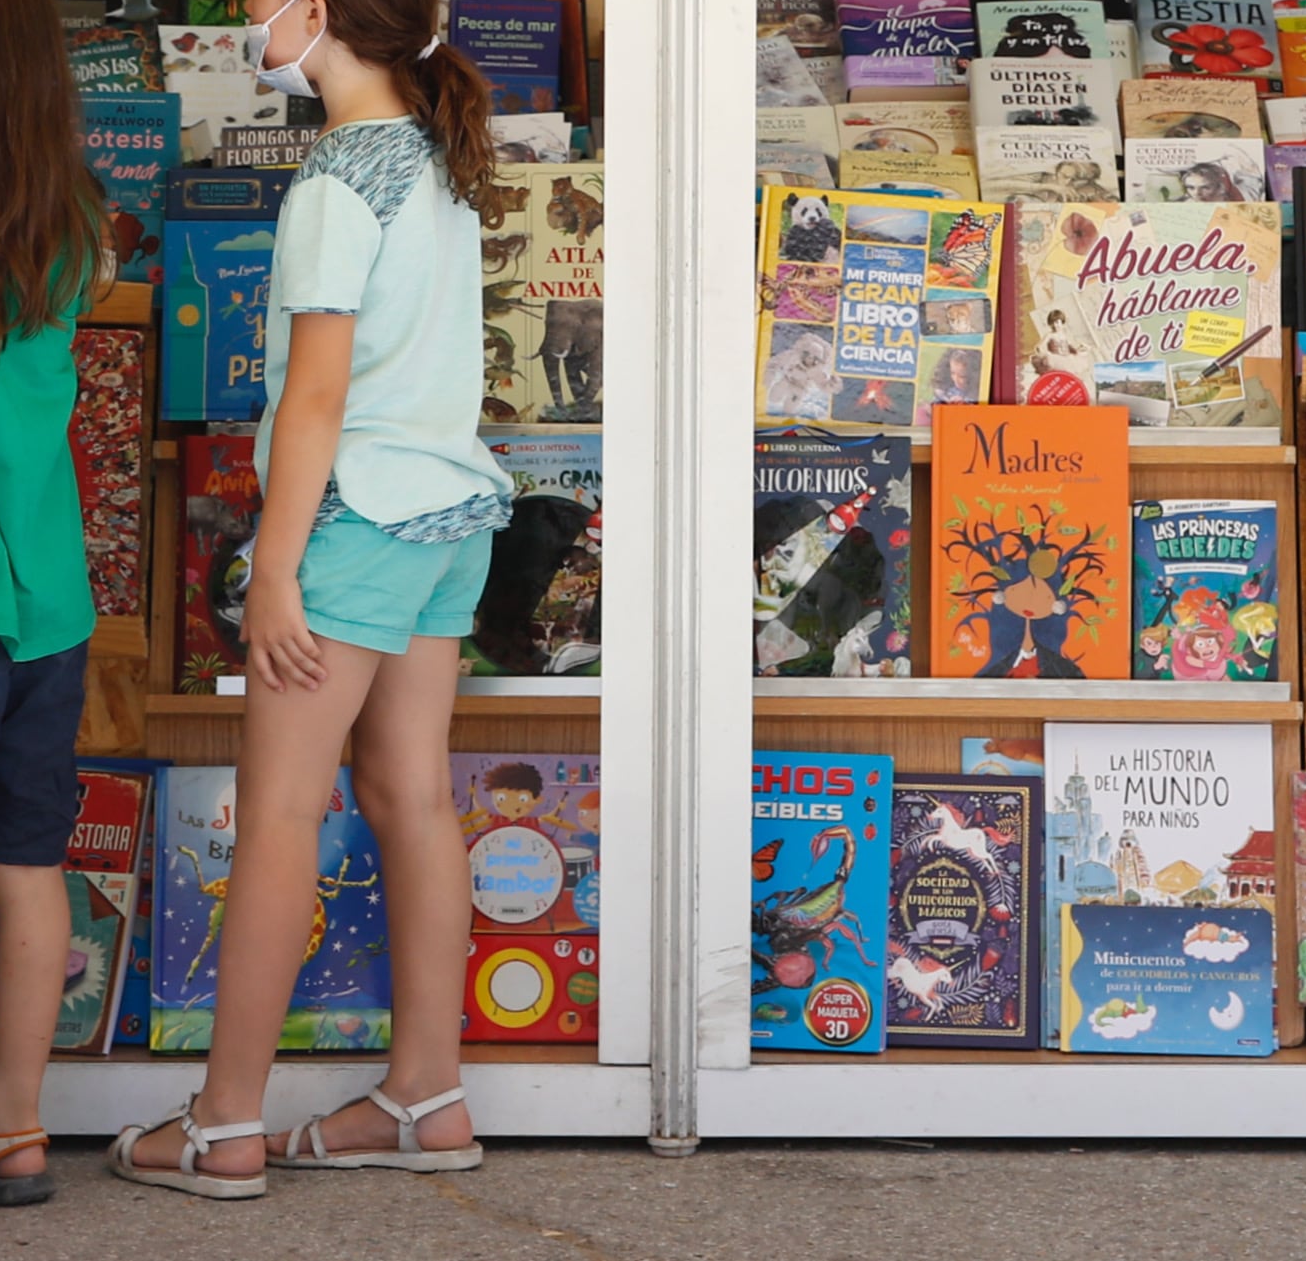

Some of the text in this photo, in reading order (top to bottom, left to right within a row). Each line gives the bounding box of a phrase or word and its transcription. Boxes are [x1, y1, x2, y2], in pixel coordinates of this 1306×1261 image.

[458, 16, 556, 34] Peces de mar
[991, 69, 1072, 82] ÚLTIMOS
[1012, 82, 1087, 93] DÍAS EN
[1002, 93, 1072, 105] BERLÍN
[236, 129, 294, 147] HONGOS
[226, 149, 279, 166] FLORES
[1078, 229, 1258, 289] Abuela,
[846, 270, 923, 286] MI PRIMER
[845, 281, 920, 304] GRAN
[1097, 282, 1240, 326] háblame
[842, 303, 919, 325] LIBRO
[842, 325, 916, 347] DE LA
[1115, 332, 1150, 362] de
[1159, 319, 1184, 352] ti
[840, 345, 915, 365] CIENCIA
[770, 443, 841, 453] LIBRO LINTERNA
[963, 422, 1083, 475] Madres
[1152, 518, 1260, 541] LAS PRINCESAS
[1155, 538, 1256, 559] REBELDES
[1110, 748, 1215, 773] LA HISTORIA
[1095, 774, 1230, 806] DEL MUNDO
[1123, 807, 1200, 829] PARA NIÑOS
[486, 853, 540, 870] primer
[474, 871, 555, 894] tambor
[916, 877, 969, 889] SOCIEDAD
[909, 894, 978, 907] UNICORNIOS
[918, 904, 967, 919] MÁGICOS
[1094, 950, 1186, 968] Minicuentos
[823, 993, 853, 1006] SUPER
[817, 1006, 860, 1020] MAQUETA
[824, 1020, 849, 1039] 3D
